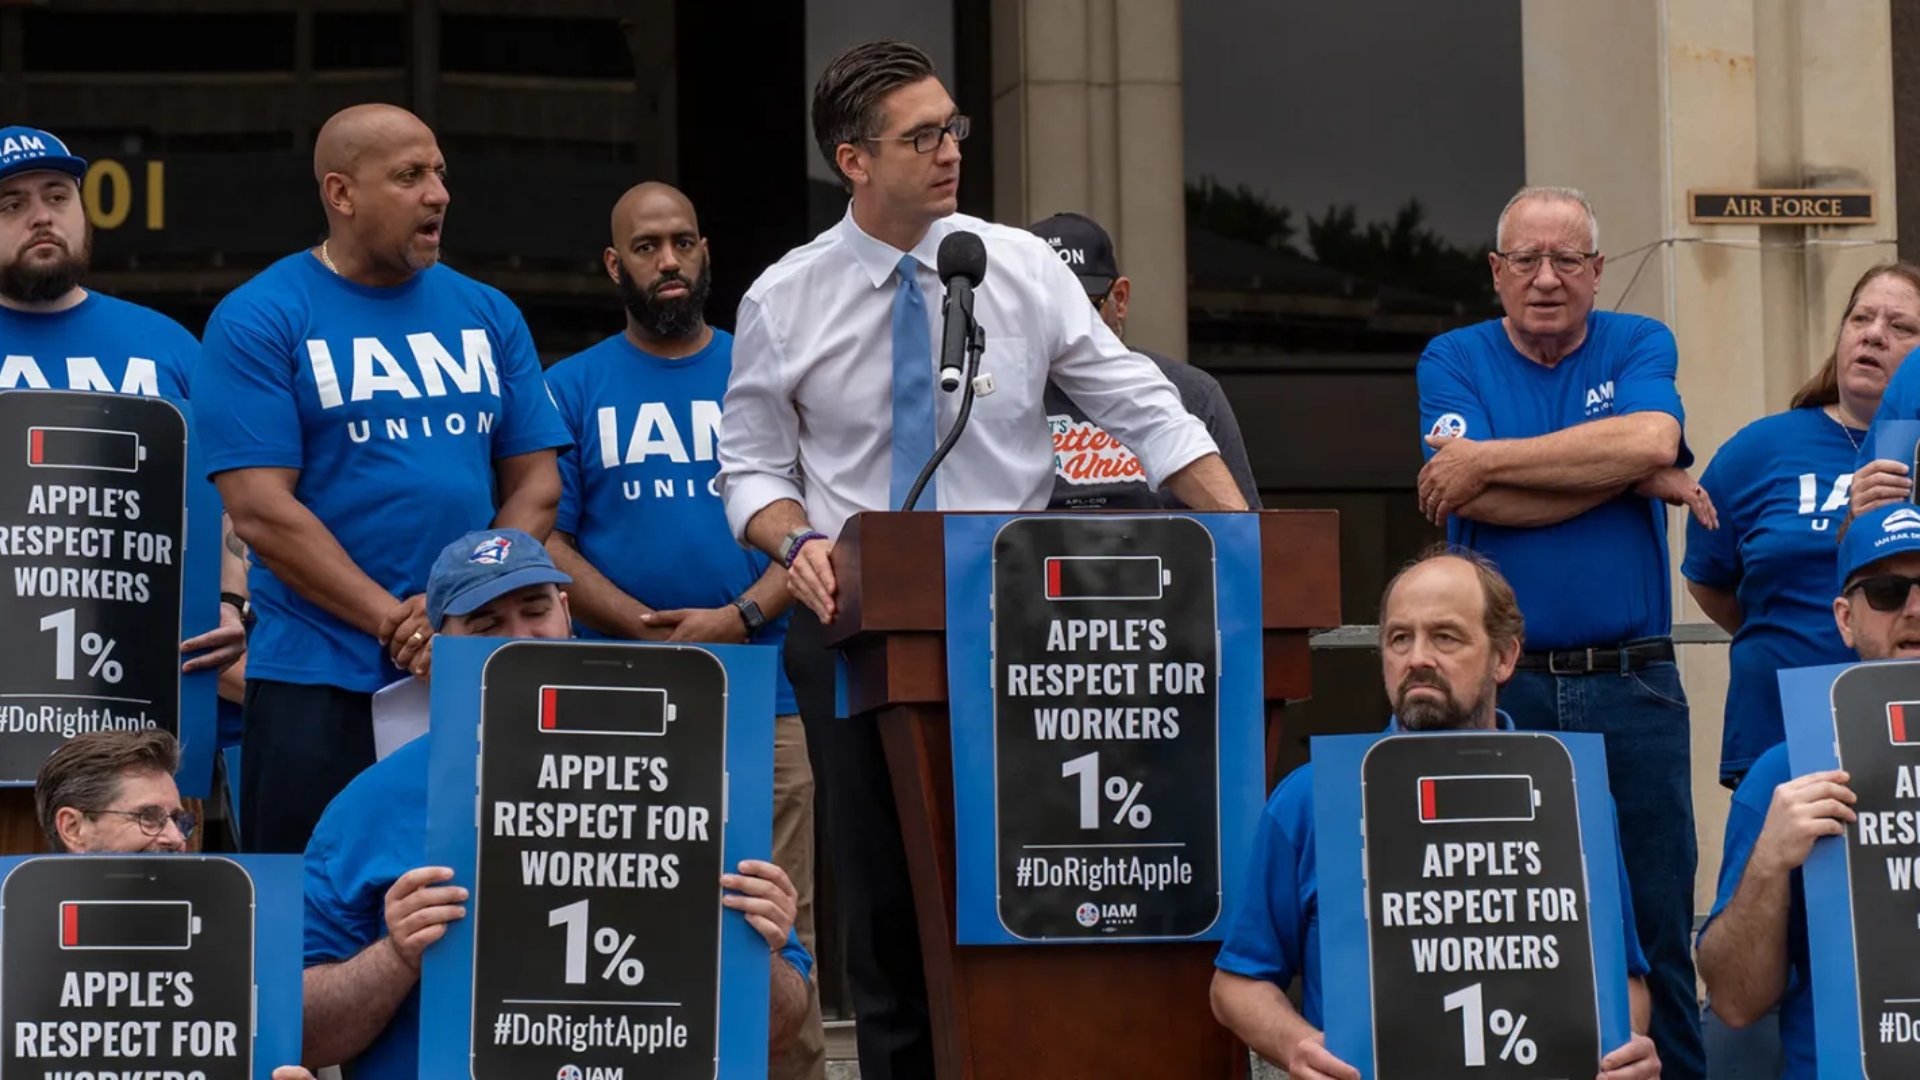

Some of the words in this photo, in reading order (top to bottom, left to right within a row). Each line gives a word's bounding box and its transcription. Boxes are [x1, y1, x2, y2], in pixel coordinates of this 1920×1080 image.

[0, 135, 46, 157] AM
[3, 151, 46, 163] UNION
[1723, 197, 1764, 216] AIR
[1770, 197, 1843, 216] FORCE
[304, 327, 501, 411] IAM
[1585, 381, 1615, 408] AM
[348, 410, 495, 444] UNION
[1048, 419, 1067, 433] T'S
[28, 485, 139, 519] APPLE'S
[622, 477, 722, 501] UNIO
[1798, 472, 1854, 515] IA
[124, 531, 171, 564] FOR
[15, 567, 148, 602] WORKERS
[40, 608, 122, 682] 1%
[1047, 619, 1166, 651] APPLE'S
[1009, 664, 1138, 695] RESPECT
[1150, 663, 1204, 694] FOR
[1035, 708, 1179, 740] WORKERS
[538, 754, 668, 791] APPLE'S
[1063, 752, 1151, 828] 1%
[494, 802, 636, 839] RESPECT
[647, 806, 709, 841] FOR
[1858, 811, 1920, 845] RES
[521, 851, 679, 888] WORKERS
[1017, 856, 1191, 891] #DoRightApple
[1423, 841, 1541, 877] APPLE'S
[1103, 904, 1136, 917] IAM
[1383, 889, 1517, 926] RESPECT
[1527, 888, 1578, 921] FOR
[549, 899, 644, 985] 1%
[1412, 935, 1559, 972] WORKERS
[60, 972, 193, 1007] APPLE'S
[16, 1022, 161, 1057] RESPECT
[173, 1021, 236, 1056] FOR
[495, 1014, 687, 1053] #DoRightApple
[1444, 983, 1537, 1066] 1%
[586, 1067, 623, 1080] IAM
